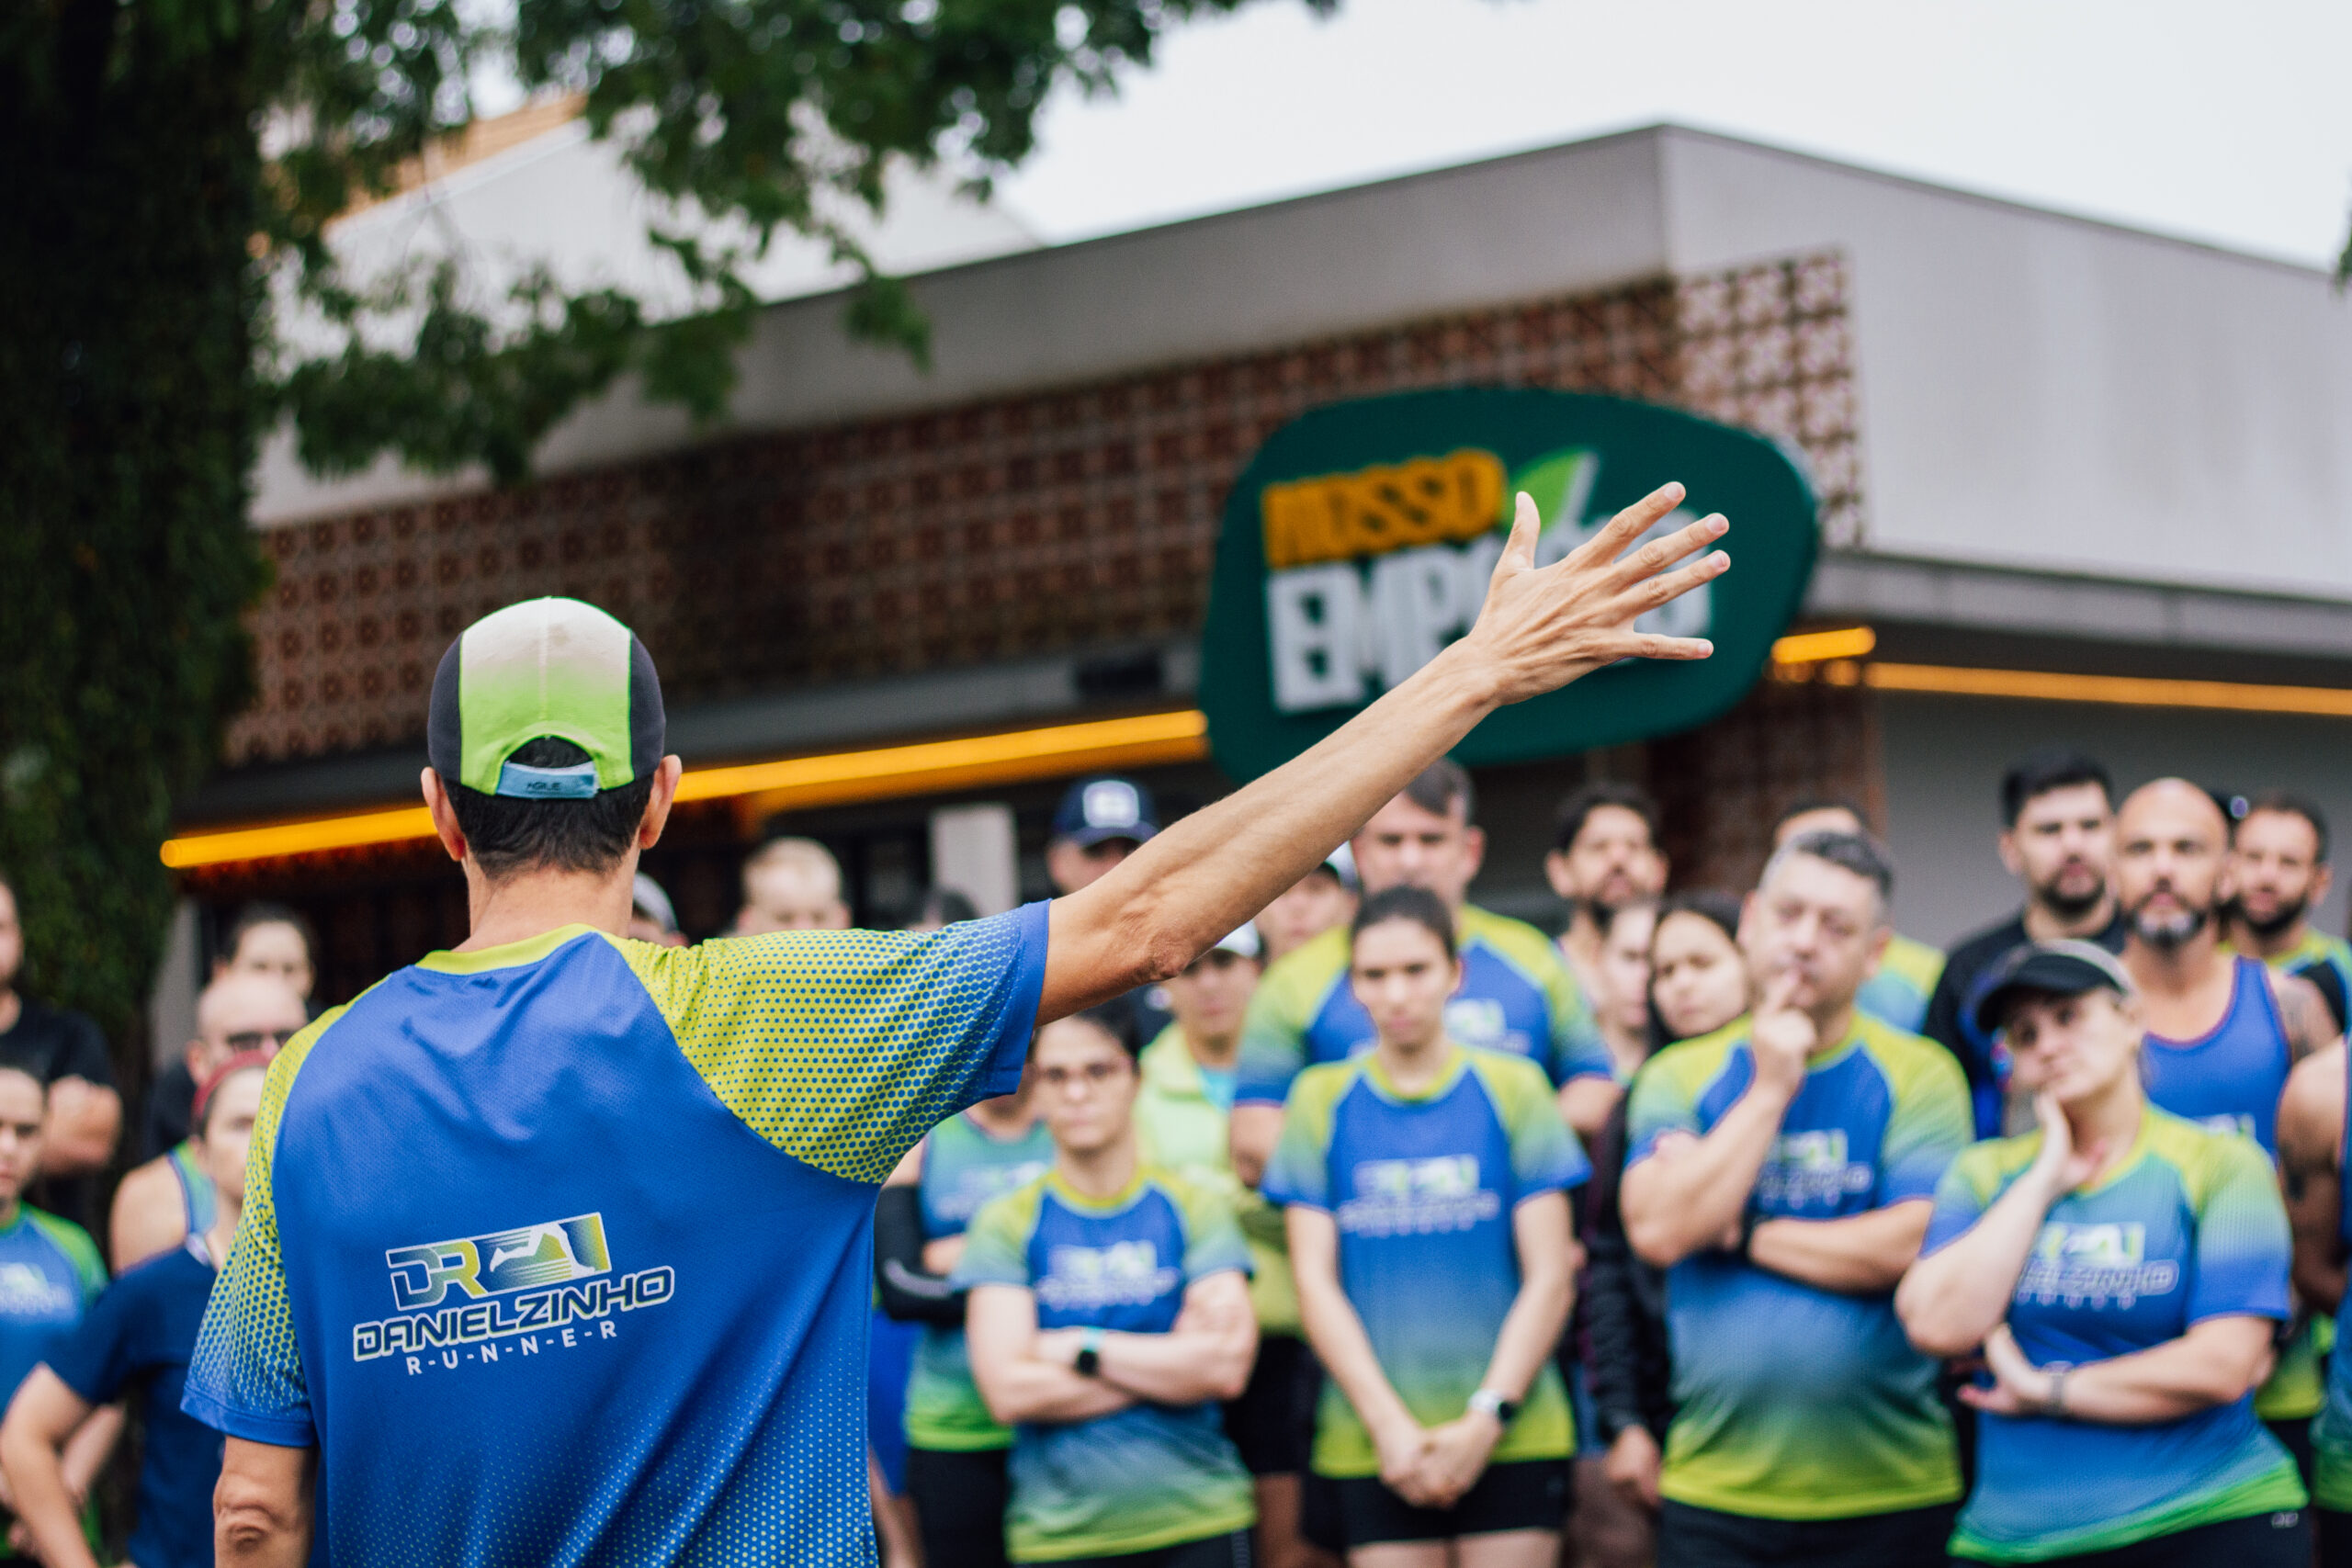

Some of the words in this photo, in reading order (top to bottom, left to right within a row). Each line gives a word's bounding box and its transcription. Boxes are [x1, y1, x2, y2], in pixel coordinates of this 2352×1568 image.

[1261, 448, 1510, 570] NOSSO
[353, 1265, 675, 1361] DANIELZINHO
[406, 1320, 618, 1376] R-U-N-N-E-R
